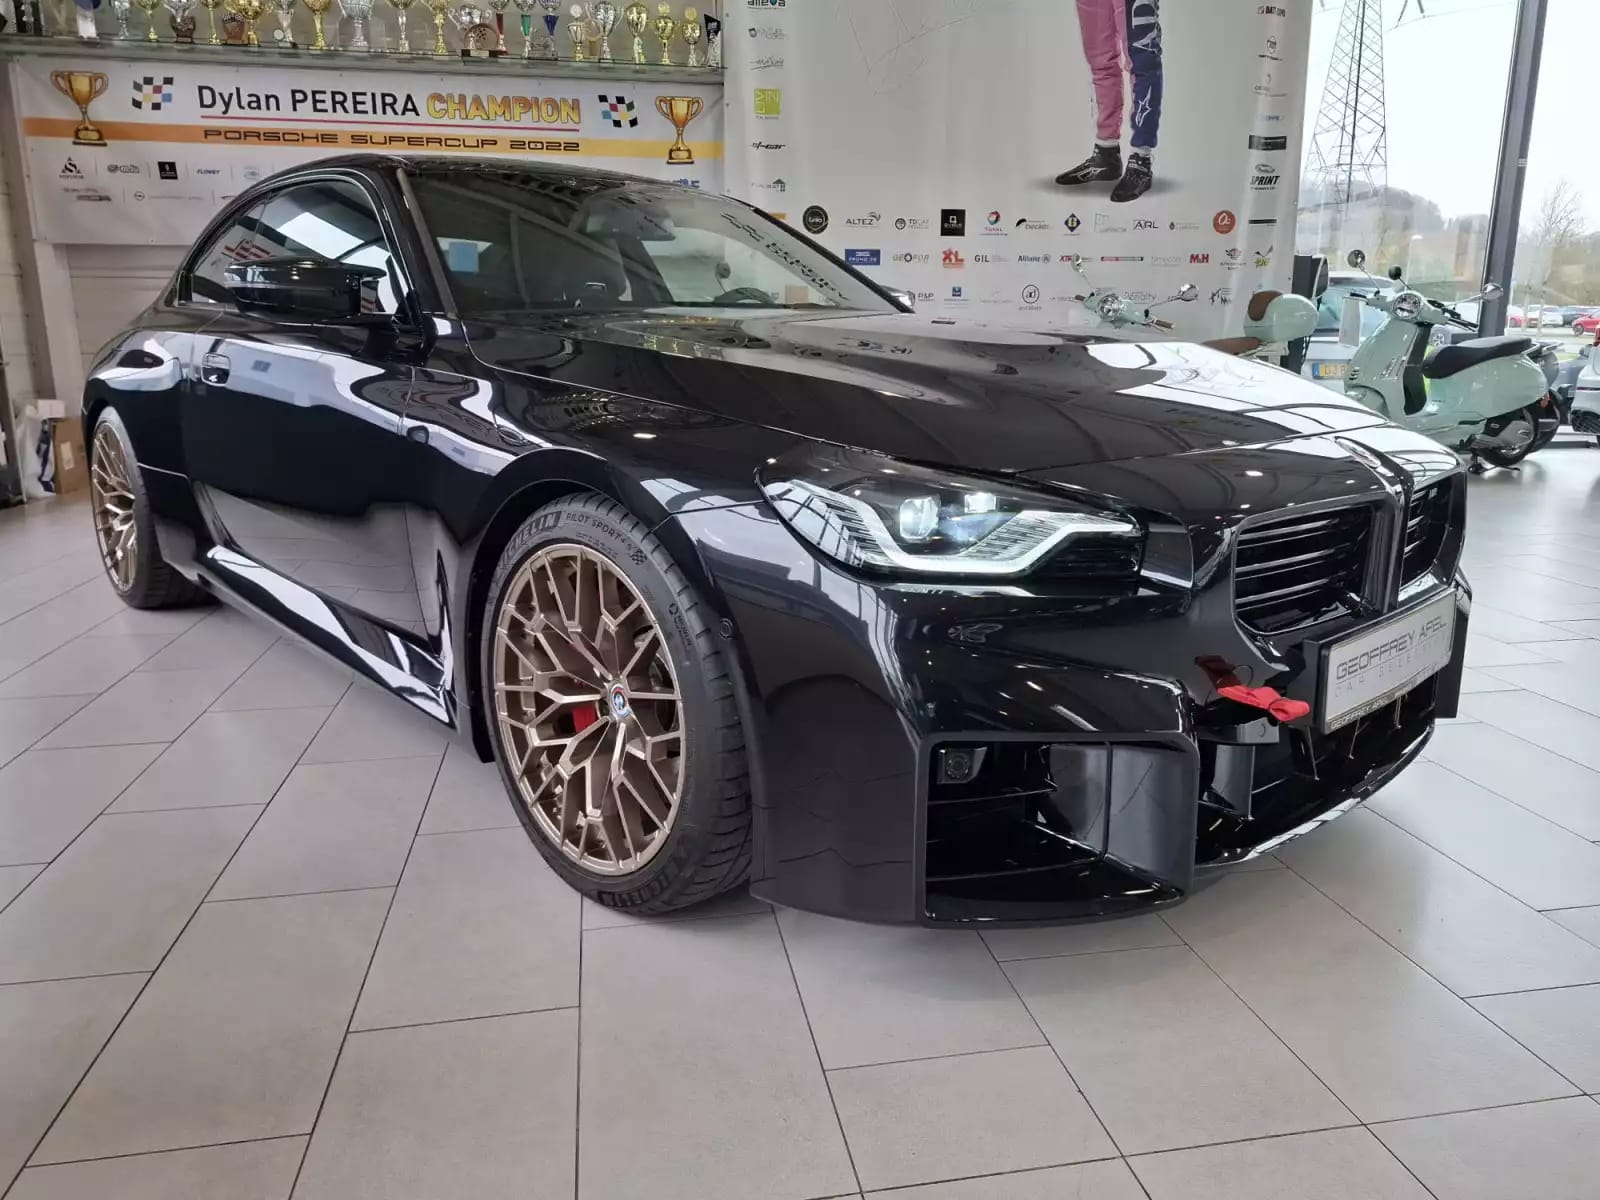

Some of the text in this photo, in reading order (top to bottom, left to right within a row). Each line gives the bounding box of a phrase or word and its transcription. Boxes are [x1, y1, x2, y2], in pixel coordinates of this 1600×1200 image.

[197, 85, 582, 124] Dylan PEREIRA CHAMPION
[204, 130, 580, 152] PORSCHE SUPERCUP 2022
[845, 218, 875, 226] ALTEZ
[974, 254, 990, 263] GIL
[1018, 255, 1041, 263] Allianz
[566, 512, 622, 540] PILOT SPORT
[1336, 629, 1416, 681] GEOFFREY
